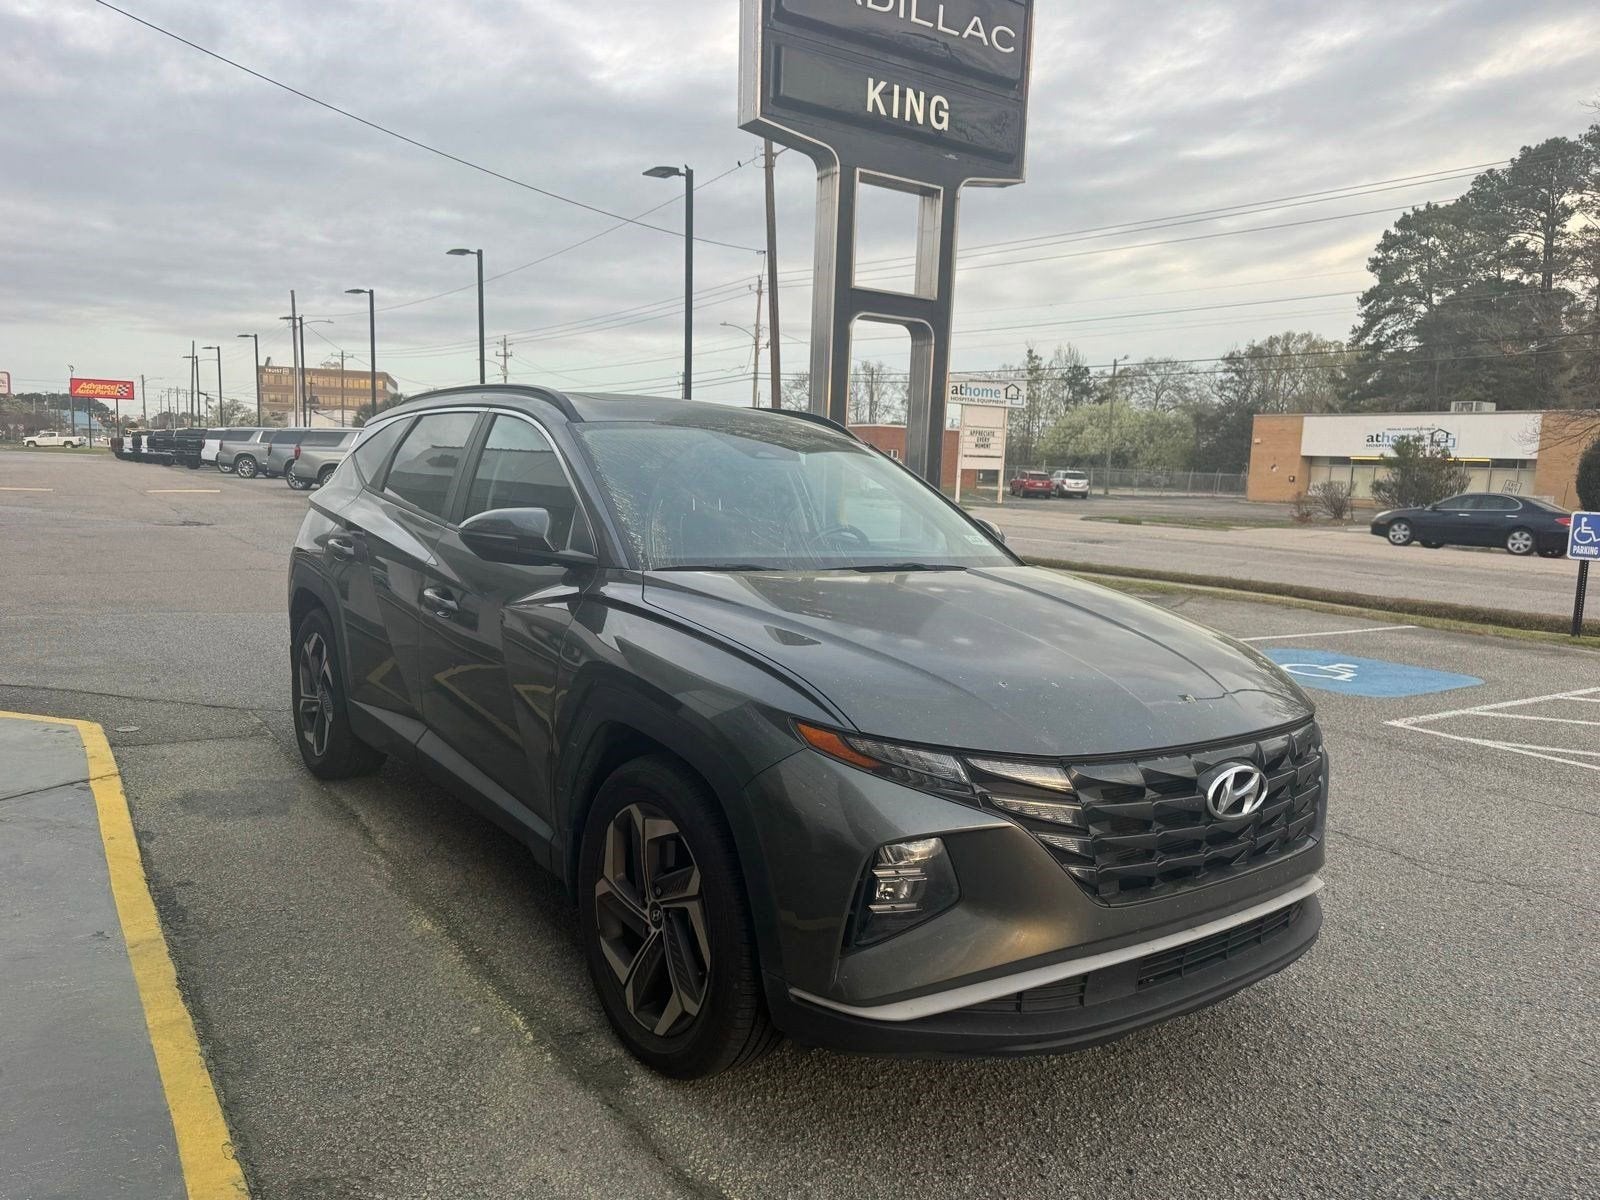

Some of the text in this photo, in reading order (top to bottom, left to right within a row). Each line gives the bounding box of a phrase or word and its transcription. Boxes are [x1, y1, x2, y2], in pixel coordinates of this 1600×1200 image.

[866, 77, 950, 132] KING
[79, 382, 116, 390] Advance
[951, 382, 1001, 398] athome
[1573, 545, 1599, 556] PARKING
